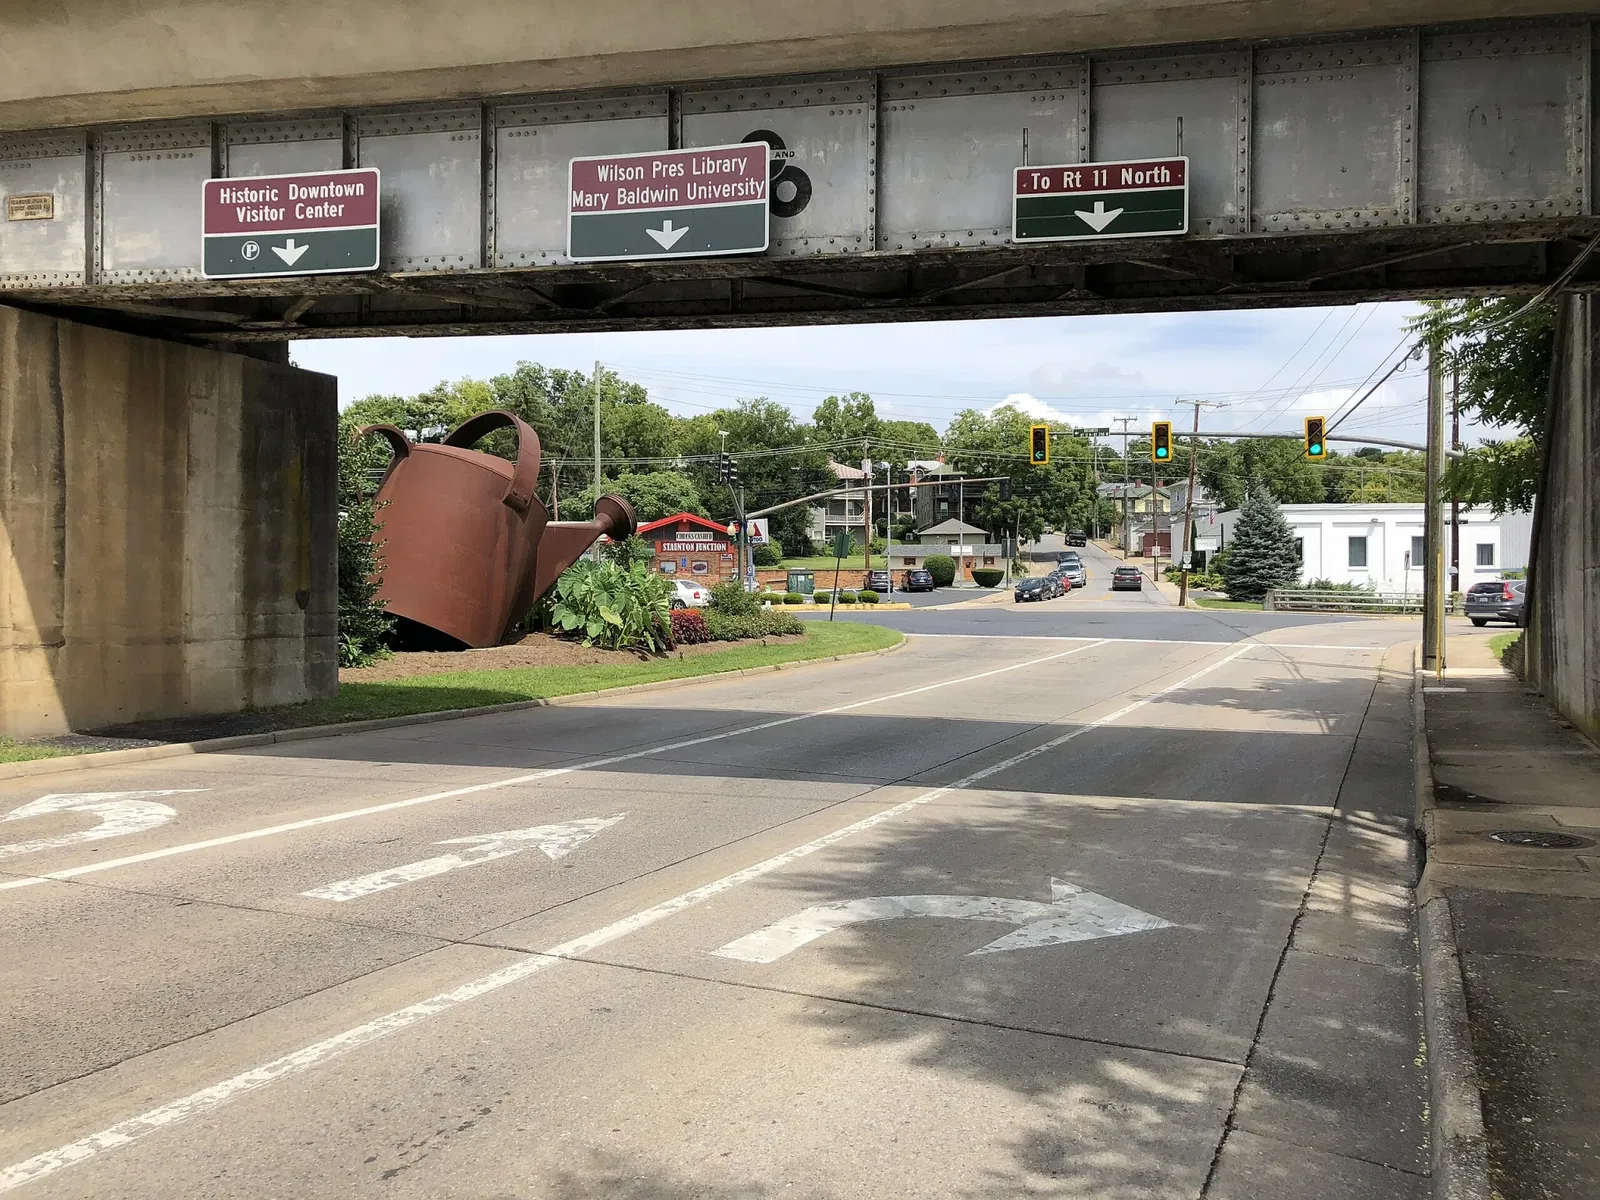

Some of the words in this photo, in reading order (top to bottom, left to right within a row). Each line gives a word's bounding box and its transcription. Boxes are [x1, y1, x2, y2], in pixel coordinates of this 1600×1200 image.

[774, 150, 795, 158] AND
[597, 165, 644, 182] Wilson
[652, 160, 684, 178] Pres
[692, 156, 748, 176] Library
[1031, 173, 1050, 190] To
[1063, 171, 1082, 189] Rt
[1093, 169, 1107, 187] 11
[1121, 165, 1170, 186] North
[220, 185, 279, 204] Historic
[288, 181, 365, 200] Downtown
[572, 189, 609, 210] Mary
[617, 184, 678, 206] Baldwin
[687, 177, 765, 200] University
[236, 205, 286, 223] Visitor
[295, 201, 345, 220] Center
[662, 543, 696, 551] STAUNTON
[696, 543, 727, 552] JUNCTION
